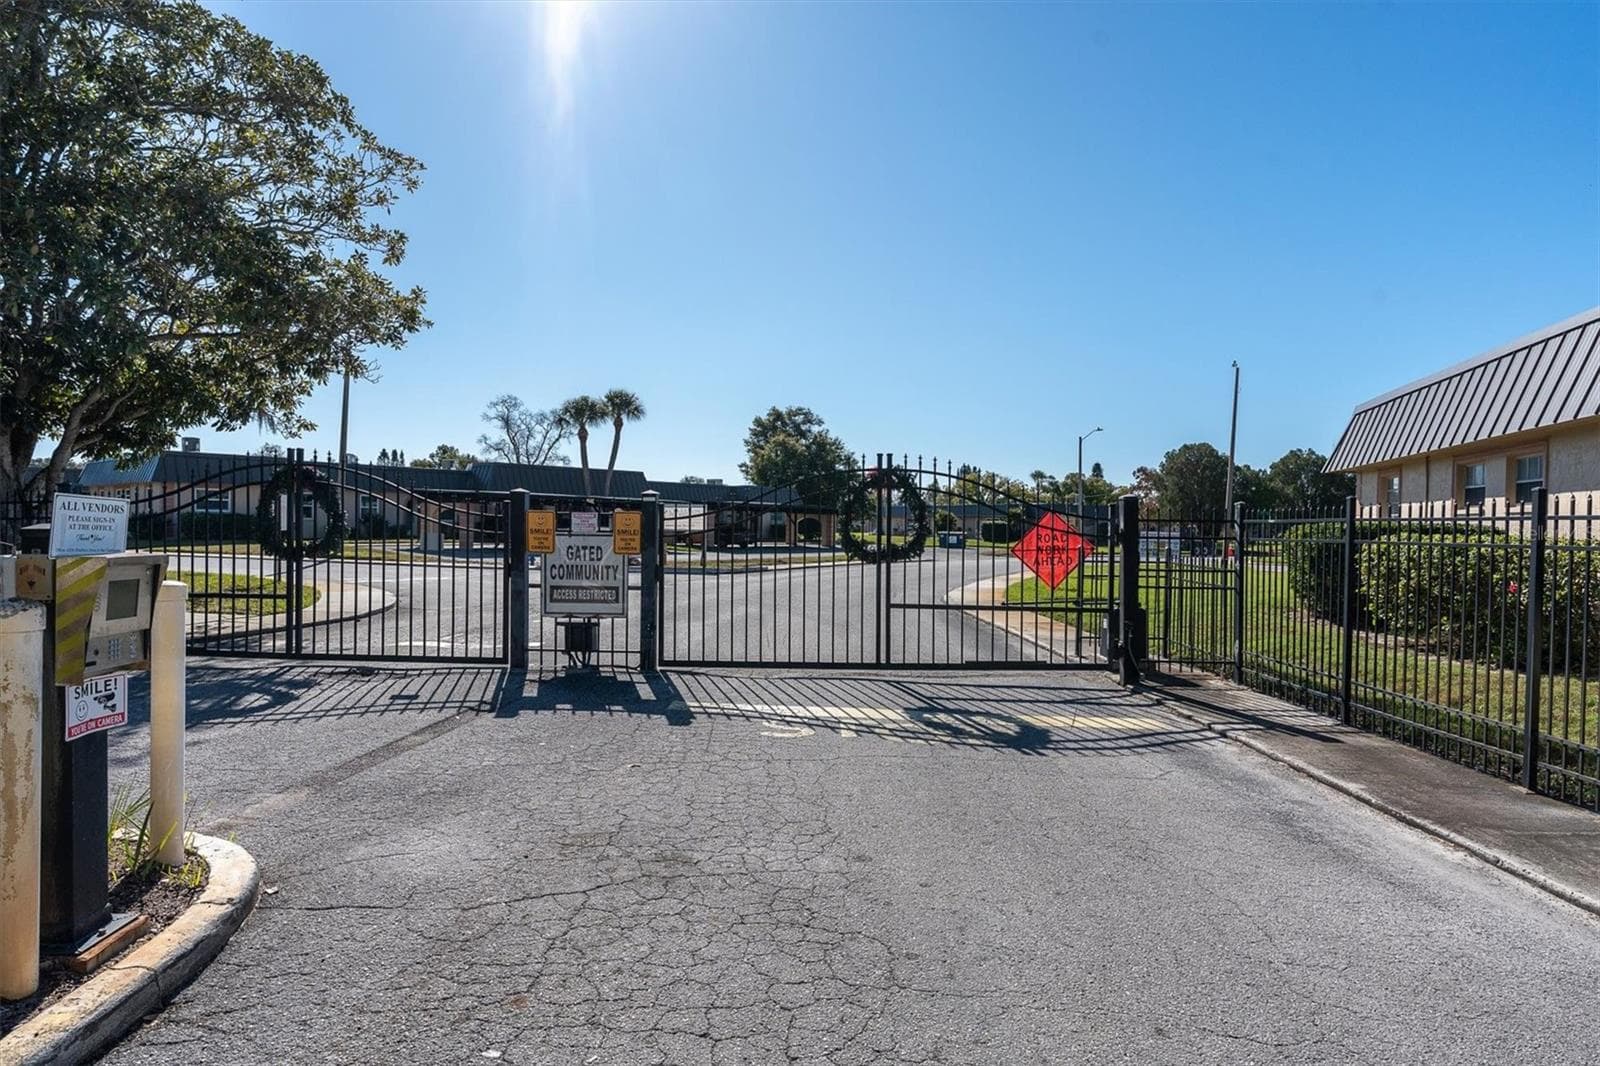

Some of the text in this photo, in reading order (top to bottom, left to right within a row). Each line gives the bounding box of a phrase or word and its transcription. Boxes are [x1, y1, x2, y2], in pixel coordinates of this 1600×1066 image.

[60, 501, 125, 513] ALL VENDORS
[1036, 533, 1068, 543] ROAD
[566, 545, 603, 561] GATED
[1036, 545, 1068, 555] WORK
[1033, 556, 1072, 566] AHEAD
[550, 564, 618, 580] COMMUNITY
[552, 589, 616, 600] ACCESS RESTRICTED
[74, 677, 118, 700] SMILE!
[87, 720, 96, 730] ON
[97, 714, 123, 728] CAMERA
